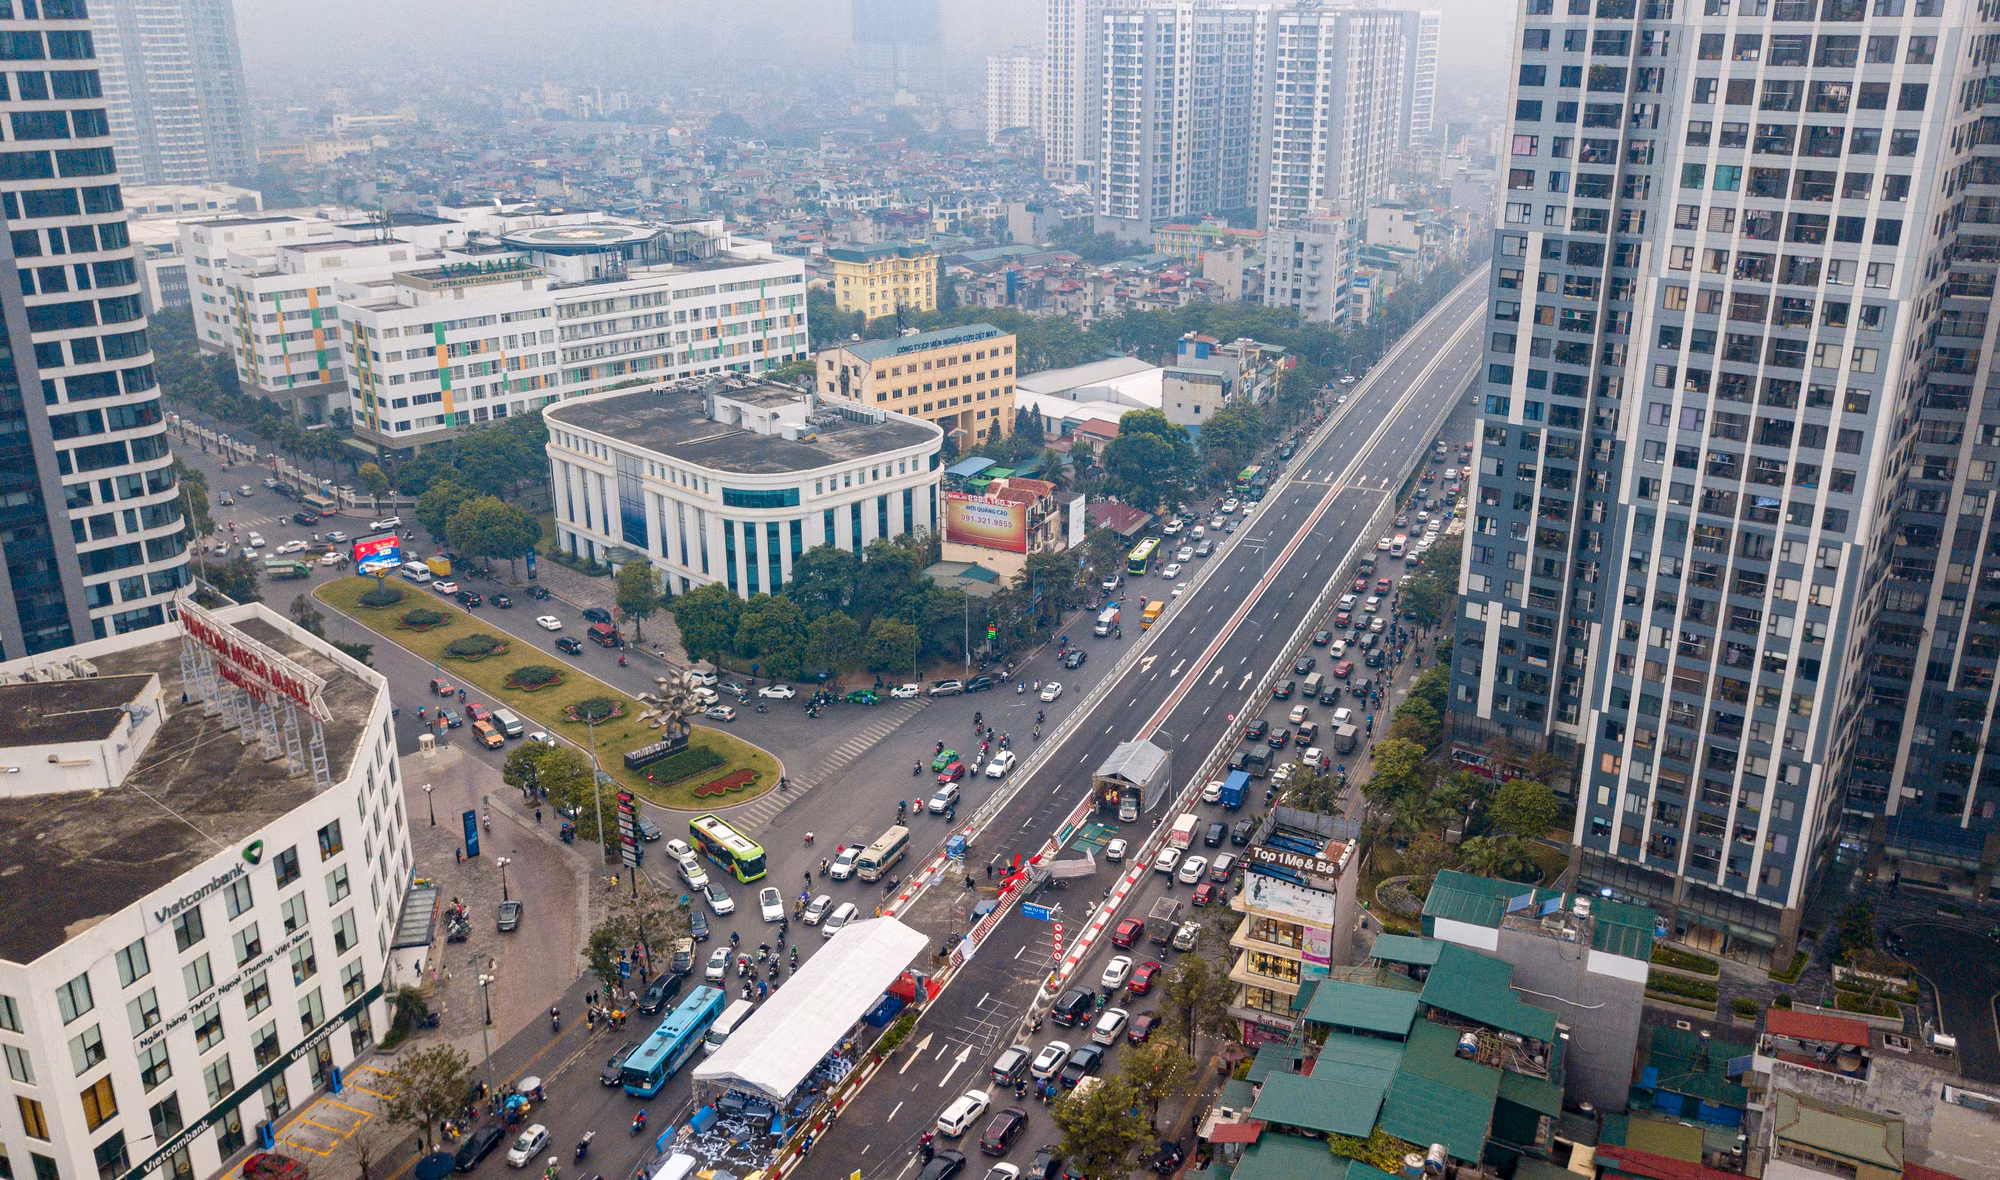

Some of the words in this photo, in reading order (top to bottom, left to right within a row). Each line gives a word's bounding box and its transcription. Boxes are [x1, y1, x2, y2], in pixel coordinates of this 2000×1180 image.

[432, 276, 502, 289] INTERNATIONAL
[504, 270, 544, 280] HOSPITAL
[961, 514, 1013, 529] 091.321.9555
[1253, 847, 1277, 863] Top
[1304, 859, 1314, 870] &
[1316, 861, 1335, 874] Bé
[154, 862, 245, 923] Vietcombank
[140, 1029, 164, 1048] Ngân
[165, 1013, 188, 1031] hàng
[188, 992, 216, 1015] TMCP
[242, 954, 274, 978] Thương
[274, 942, 291, 956] Việt
[291, 930, 310, 945] Nam
[290, 1016, 345, 1061] Vietcombank
[143, 1120, 209, 1173] Vietcombank
